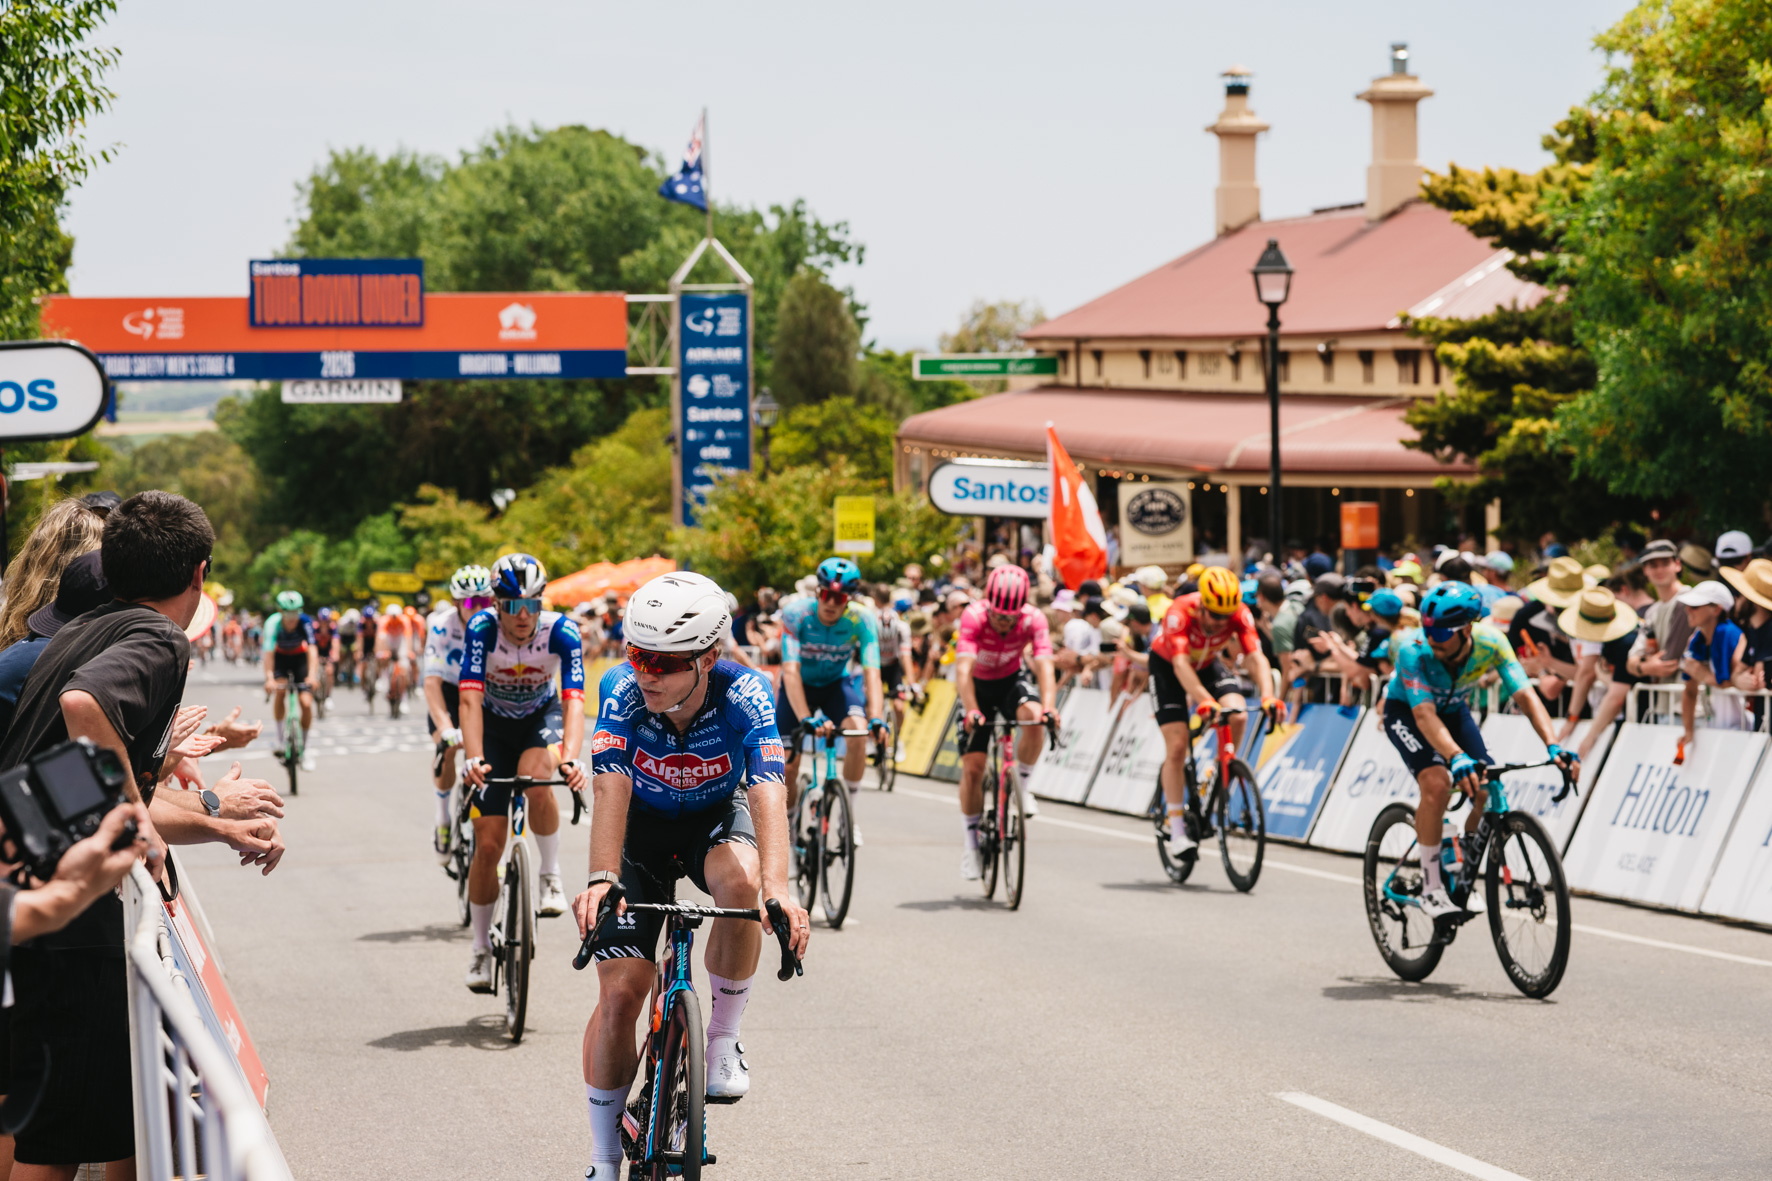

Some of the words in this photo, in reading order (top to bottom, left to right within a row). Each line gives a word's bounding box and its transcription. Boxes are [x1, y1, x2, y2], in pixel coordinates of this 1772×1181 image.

[251, 262, 299, 275] Santos
[290, 379, 394, 397] GARMIN
[687, 406, 743, 422] Santos
[953, 477, 1048, 505] Santos
[634, 621, 658, 632] CANYON
[699, 614, 728, 645] CANYON
[470, 639, 484, 674] BOSS
[570, 648, 584, 682] BOSS
[731, 672, 776, 727] Alpecin
[592, 736, 621, 748] pecin
[689, 724, 720, 738] CANYON
[641, 758, 722, 780] Alpecin
[1611, 763, 1710, 837] Hilton
